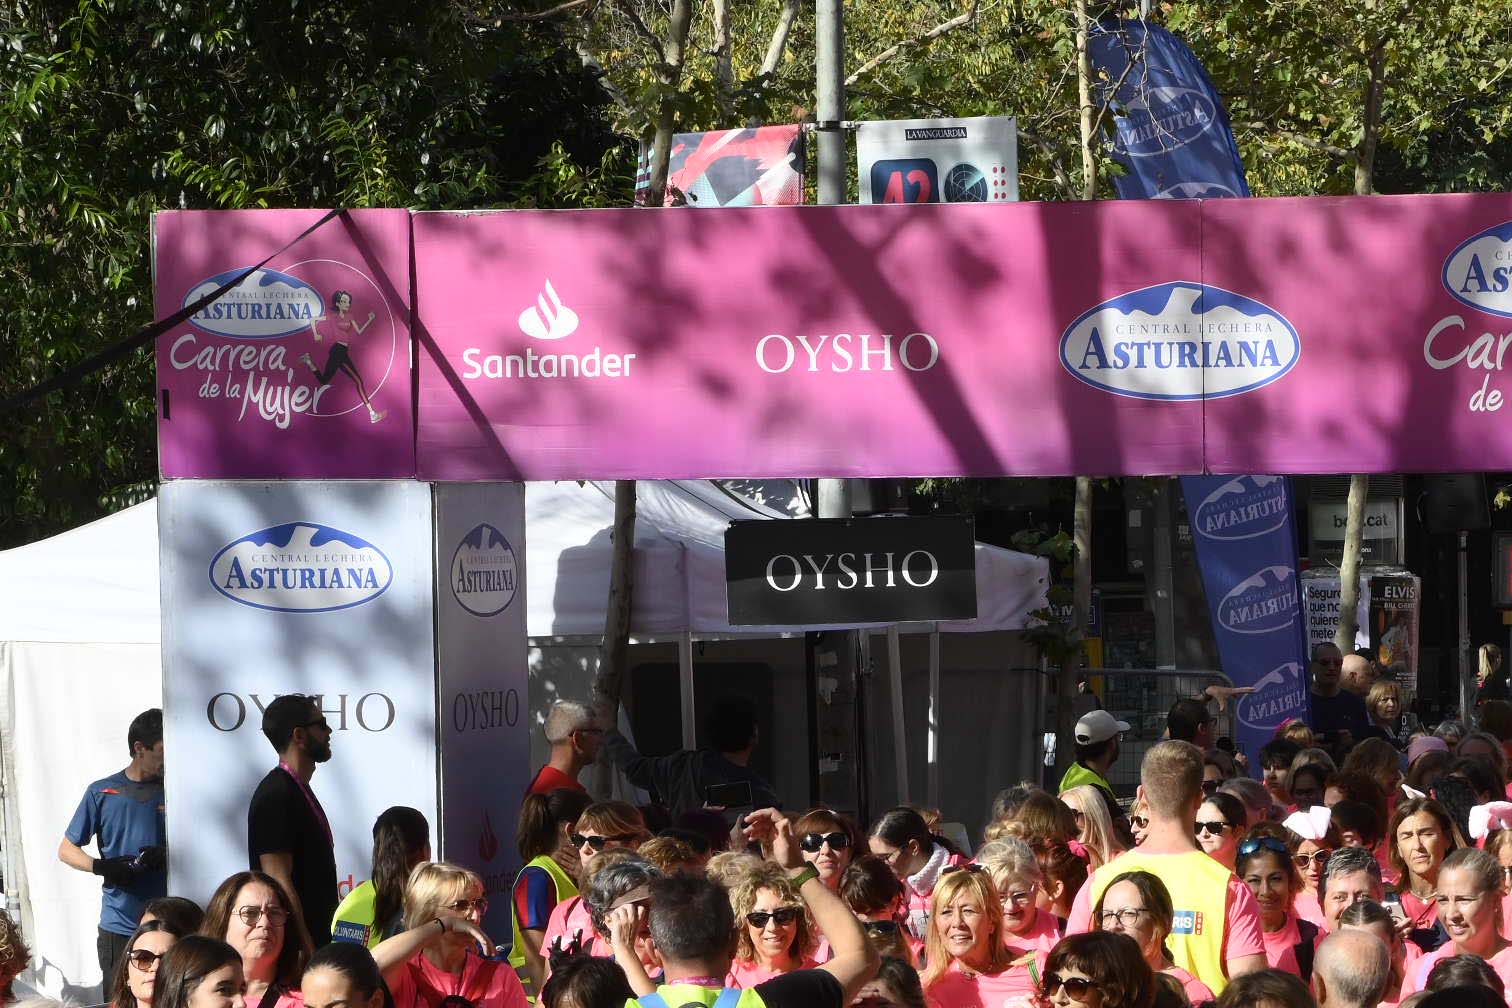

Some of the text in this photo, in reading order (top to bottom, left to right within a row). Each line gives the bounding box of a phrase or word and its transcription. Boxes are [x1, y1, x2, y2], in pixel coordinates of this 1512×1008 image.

[914, 129, 966, 139] VANGUARDIA
[193, 294, 312, 320] ASTURIANA
[222, 291, 308, 299] ENTRAL LECHERA
[1116, 322, 1273, 335] CENTRAL LECHERA
[170, 334, 287, 371] Carrera
[463, 346, 635, 379] Santander
[755, 332, 939, 374] OYSHO
[1078, 326, 1281, 369] ASTURIANA
[199, 367, 333, 430] de la Mujer
[1469, 373, 1504, 413] de
[224, 556, 380, 590] ASTURIANA
[251, 553, 374, 563] CENTRAL LECHERA
[766, 550, 938, 592] OYSHO
[456, 558, 515, 594] ASTURIANA
[1384, 586, 1415, 599] ELVIS
[1310, 615, 1341, 628] quiere
[206, 692, 396, 733] OHO
[453, 688, 520, 732] OYSHO
